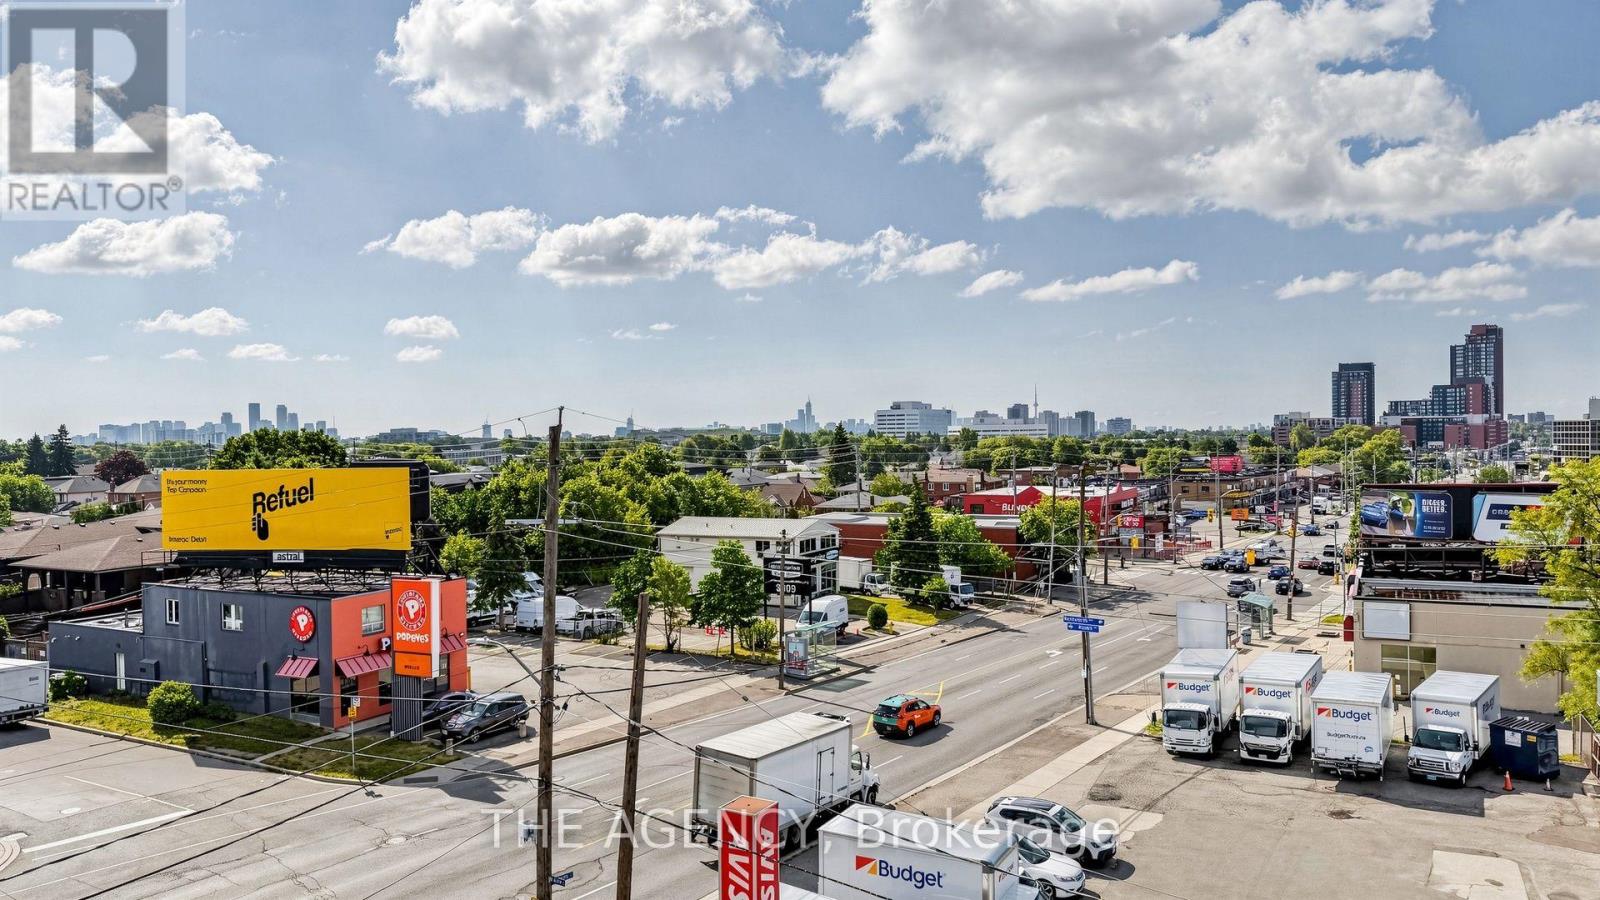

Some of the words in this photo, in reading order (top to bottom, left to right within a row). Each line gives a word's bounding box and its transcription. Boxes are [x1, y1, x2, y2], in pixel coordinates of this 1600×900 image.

[253, 478, 314, 515] Refuel
[277, 552, 300, 561] astral
[1178, 682, 1211, 693] Budget
[1257, 688, 1292, 699] Budget
[1332, 708, 1372, 722] Budget
[1434, 708, 1460, 717] Budget
[879, 859, 943, 889] Budget
